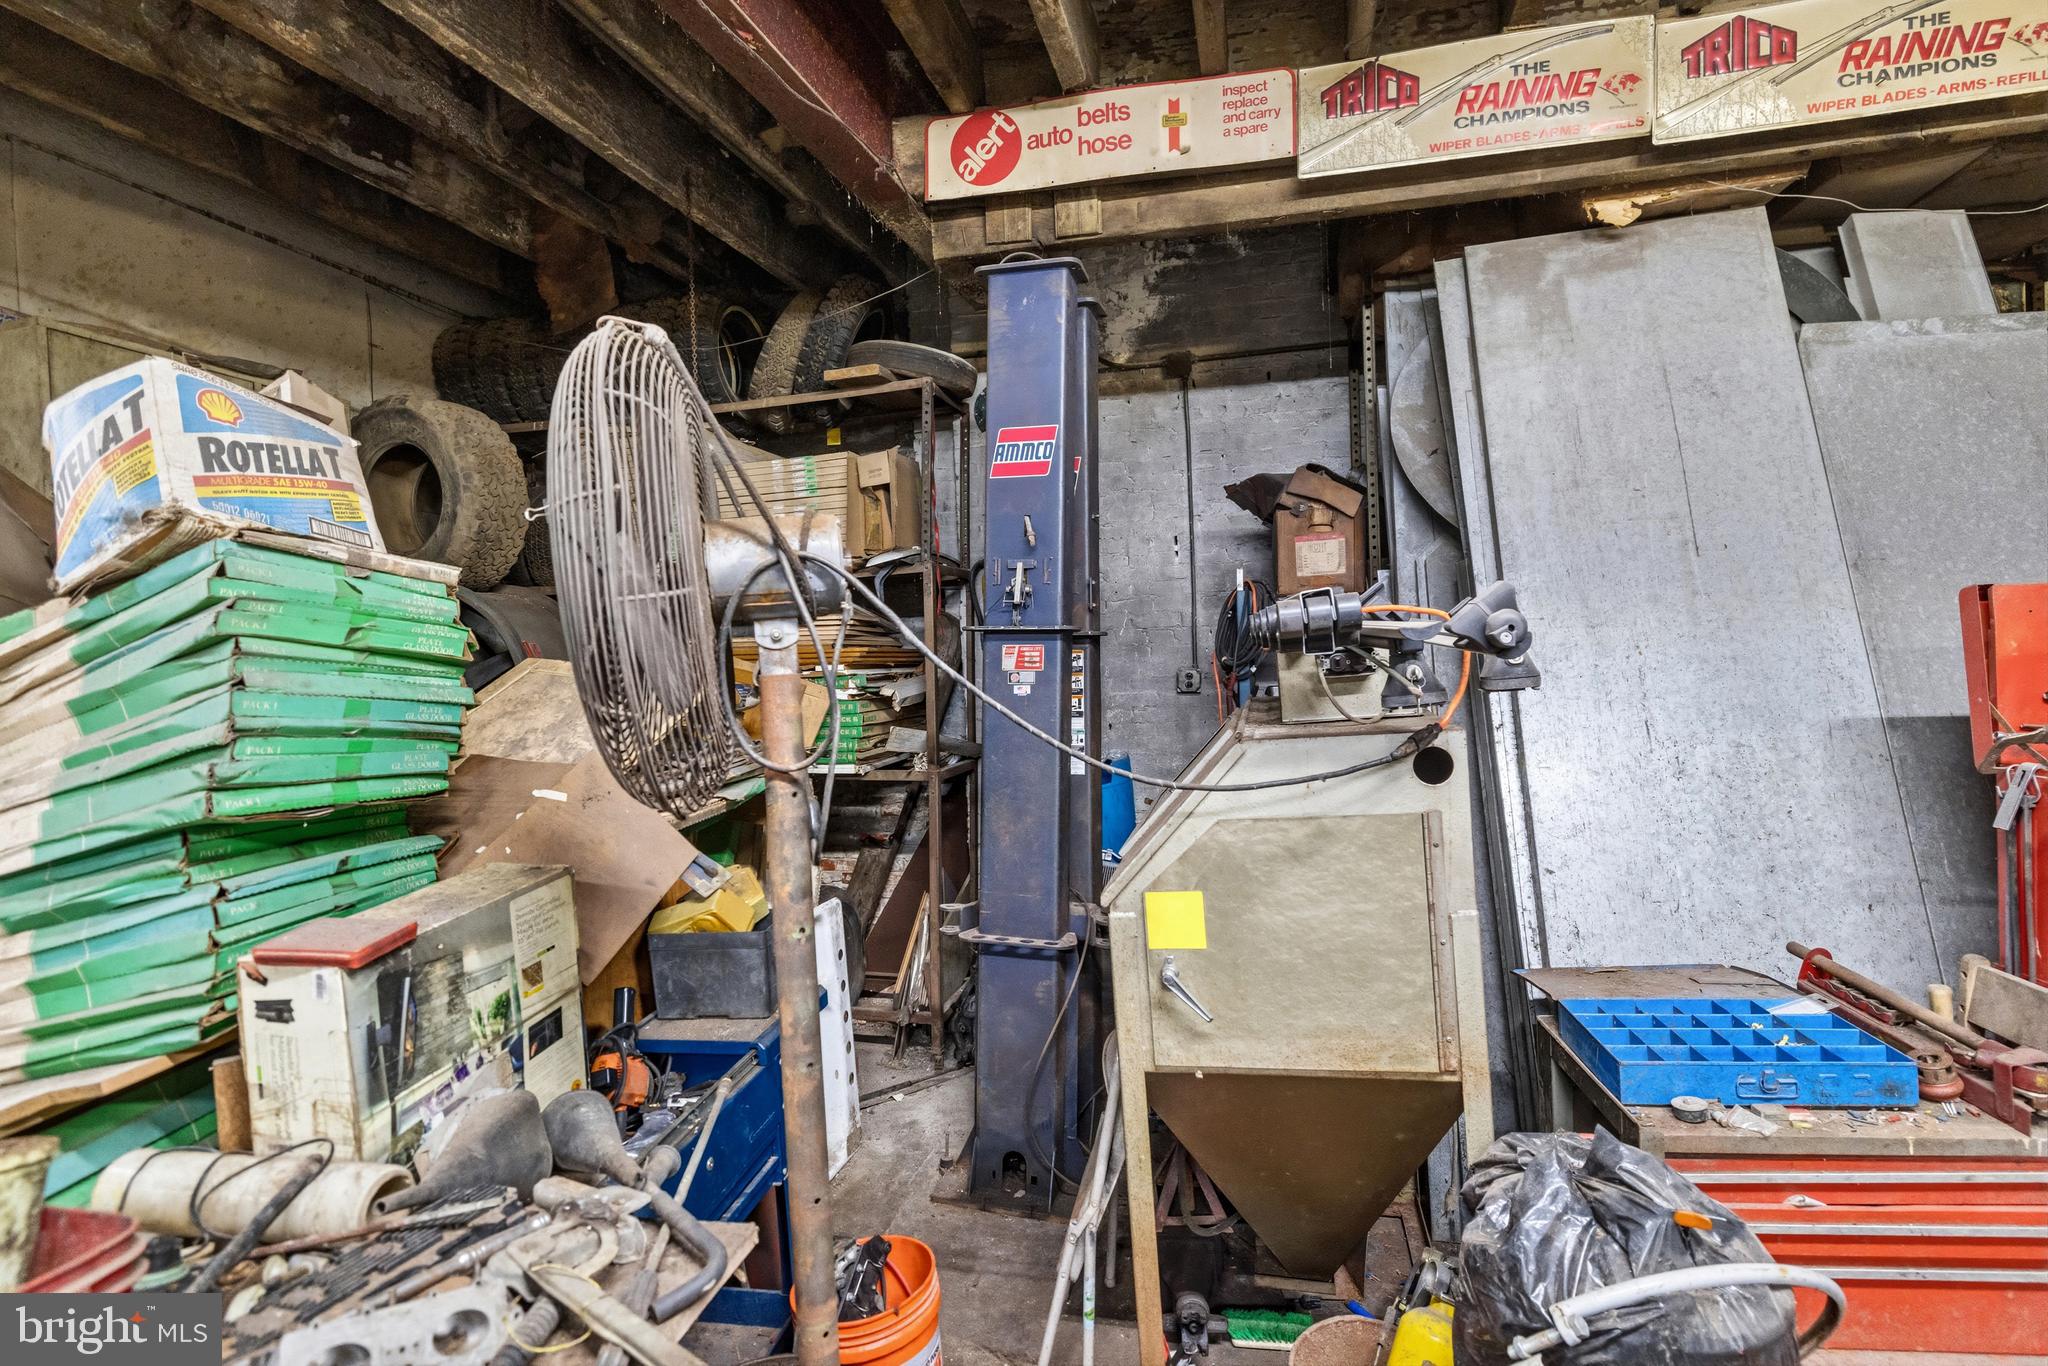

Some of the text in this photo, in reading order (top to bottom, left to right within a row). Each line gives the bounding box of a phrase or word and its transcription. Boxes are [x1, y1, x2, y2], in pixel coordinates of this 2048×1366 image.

[1903, 11, 1951, 30] THE
[1681, 15, 1798, 78] TRICO
[1838, 17, 2012, 73] RAINING
[1510, 60, 1551, 77] THE
[1837, 53, 1998, 88] CHAMPIONS
[1222, 80, 1268, 97] inspect
[1321, 60, 1420, 120] TRICO
[1455, 68, 1602, 117] RAINING
[1077, 102, 1131, 127] belts
[1222, 96, 1268, 111] replace
[1222, 107, 1281, 124] and carry
[1454, 100, 1591, 130] CHAMPIONS
[1807, 97, 1857, 115] WIPER
[1027, 126, 1073, 150] auto
[1223, 123, 1268, 138] a spare
[958, 112, 1017, 182] alert
[1077, 132, 1132, 156] hose
[1429, 138, 1473, 153] WIPER
[197, 436, 328, 478] ROTELLA
[994, 441, 1054, 462] AMMCO
[210, 475, 328, 489] MULTIGRADE SAE 15W-40
